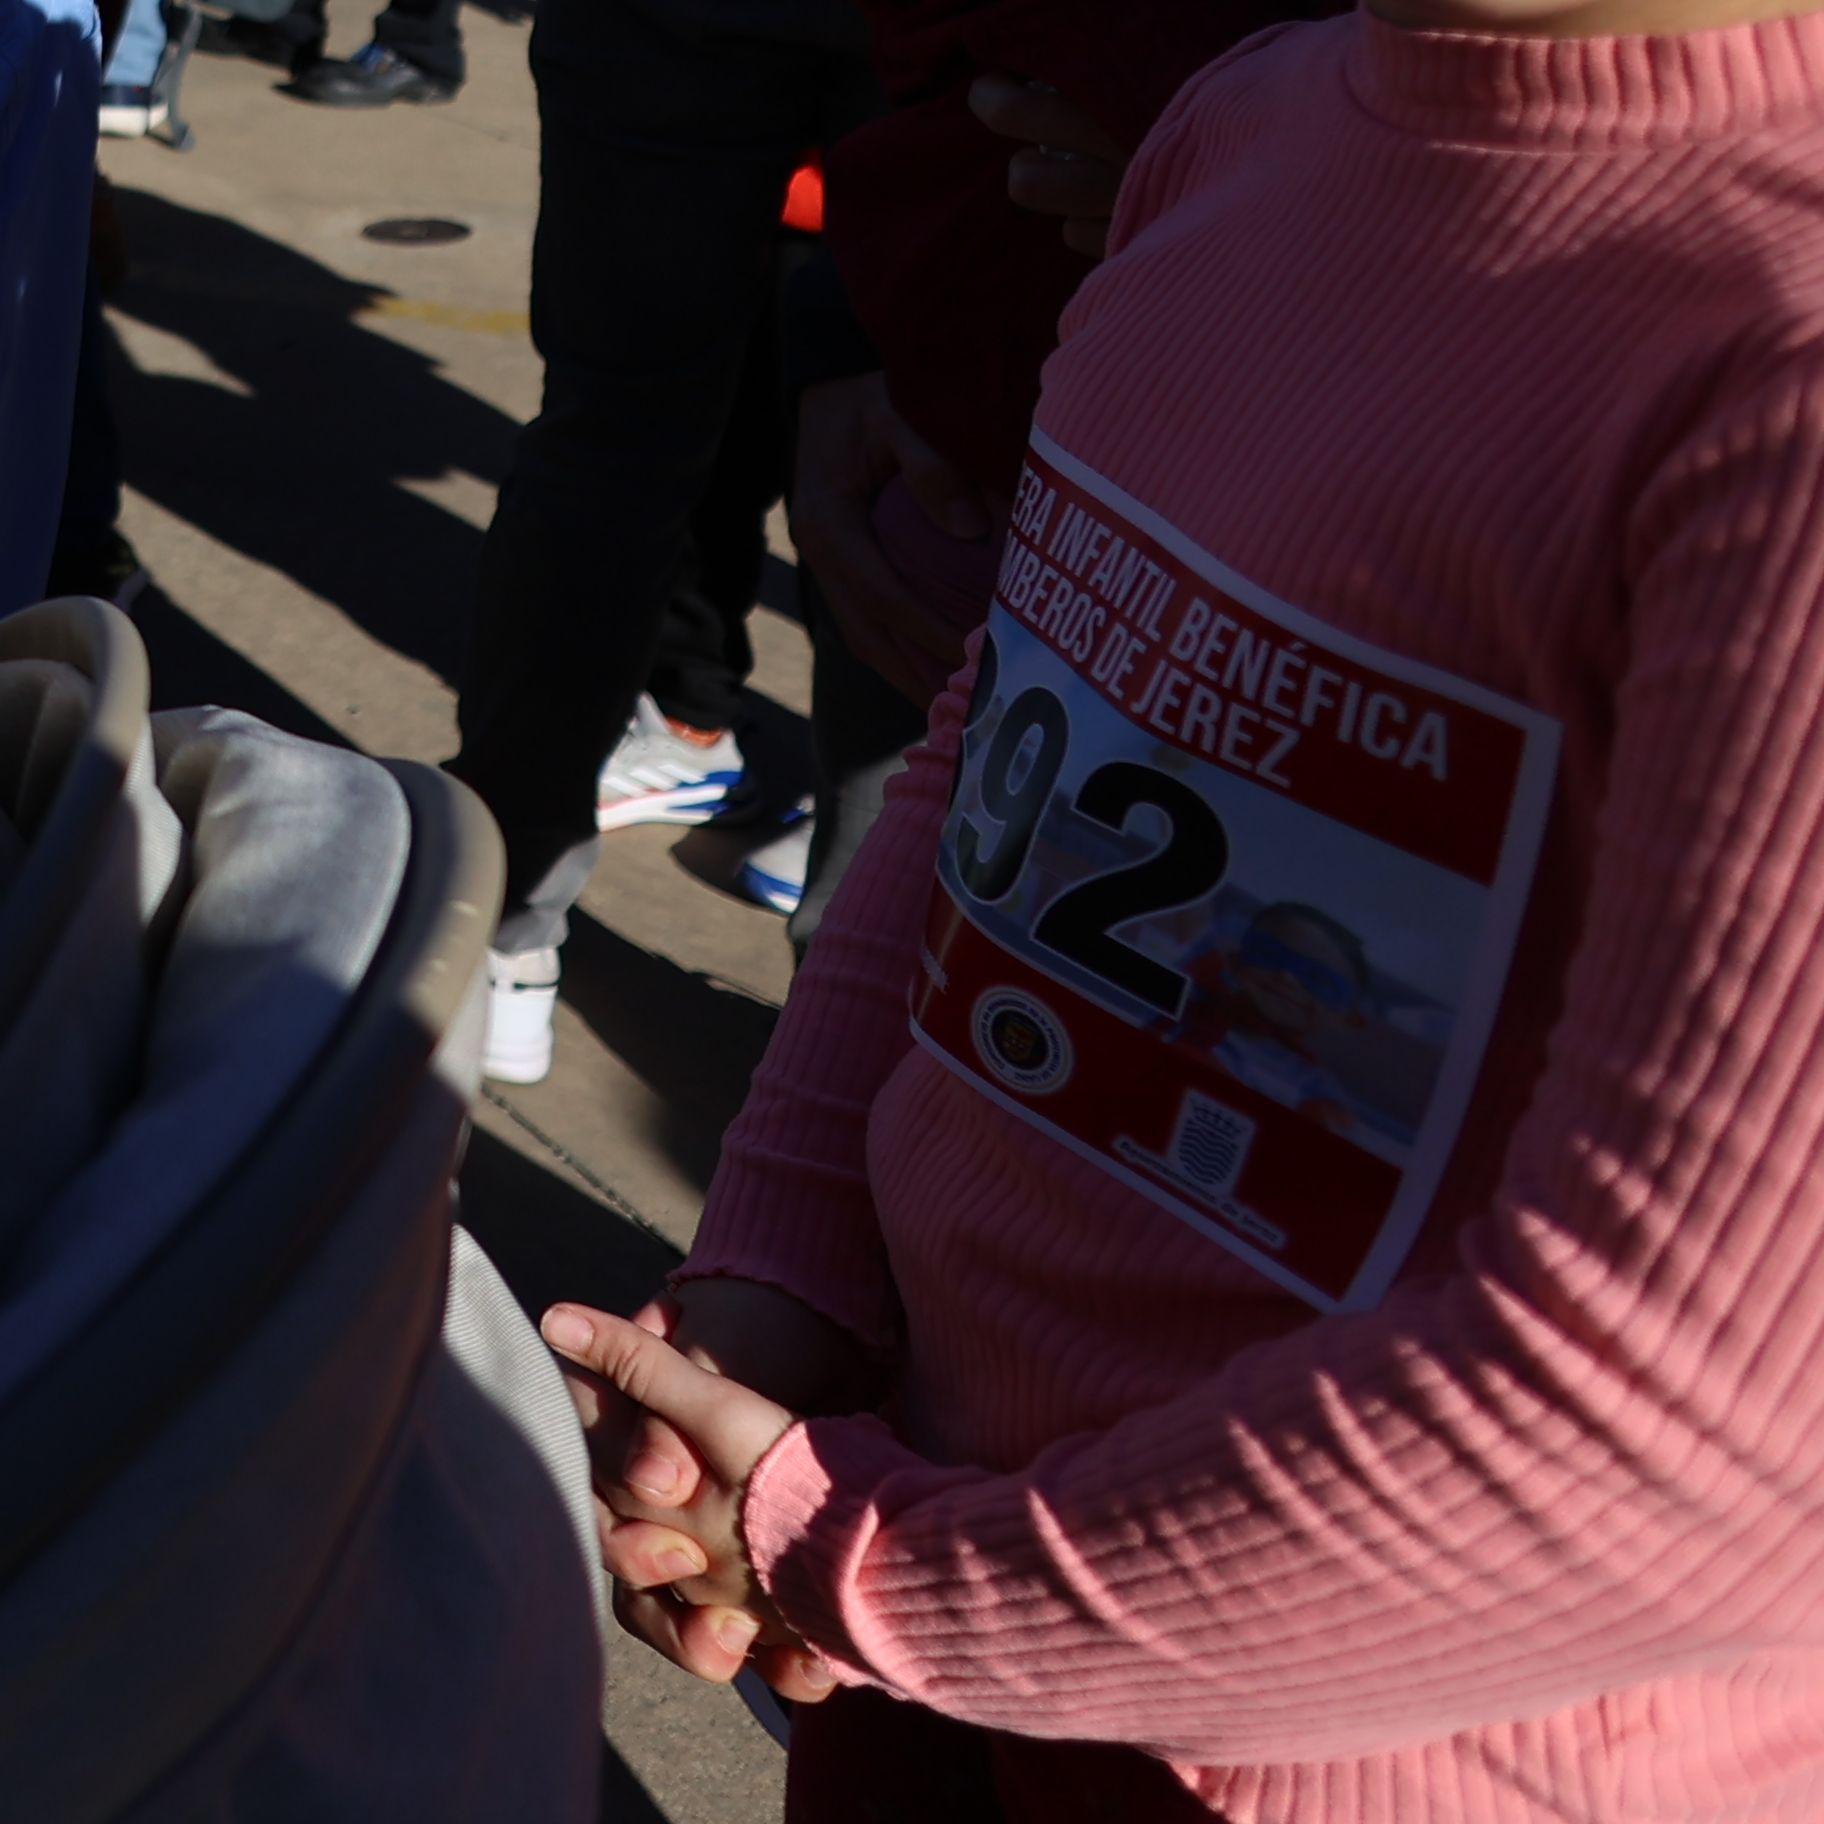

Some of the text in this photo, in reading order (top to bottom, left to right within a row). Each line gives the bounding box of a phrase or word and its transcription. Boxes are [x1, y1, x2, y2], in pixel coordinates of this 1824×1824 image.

[996, 526, 1302, 790] MBEROS DE JEREZ
[1045, 500, 1177, 643] INFANTIL
[1167, 595, 1449, 783] BENÉFICA
